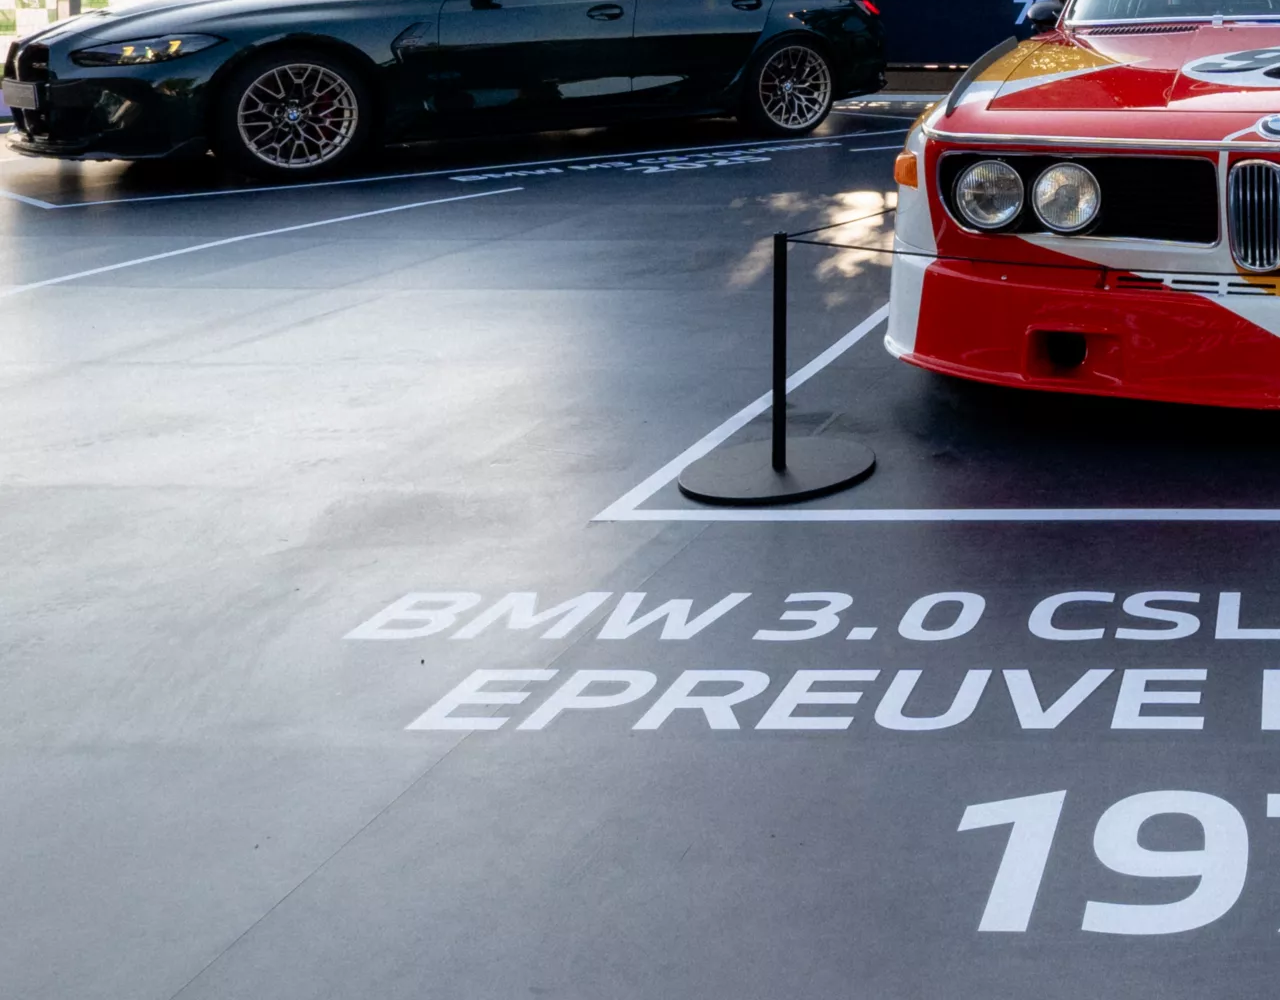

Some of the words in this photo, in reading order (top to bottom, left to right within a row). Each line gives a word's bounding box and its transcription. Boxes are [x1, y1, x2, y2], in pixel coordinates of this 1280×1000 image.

[448, 167, 564, 182] BMW
[623, 155, 772, 174] 2025
[342, 591, 752, 641] BMW
[752, 591, 986, 642] 3.0
[403, 669, 1208, 731] EPREUVE
